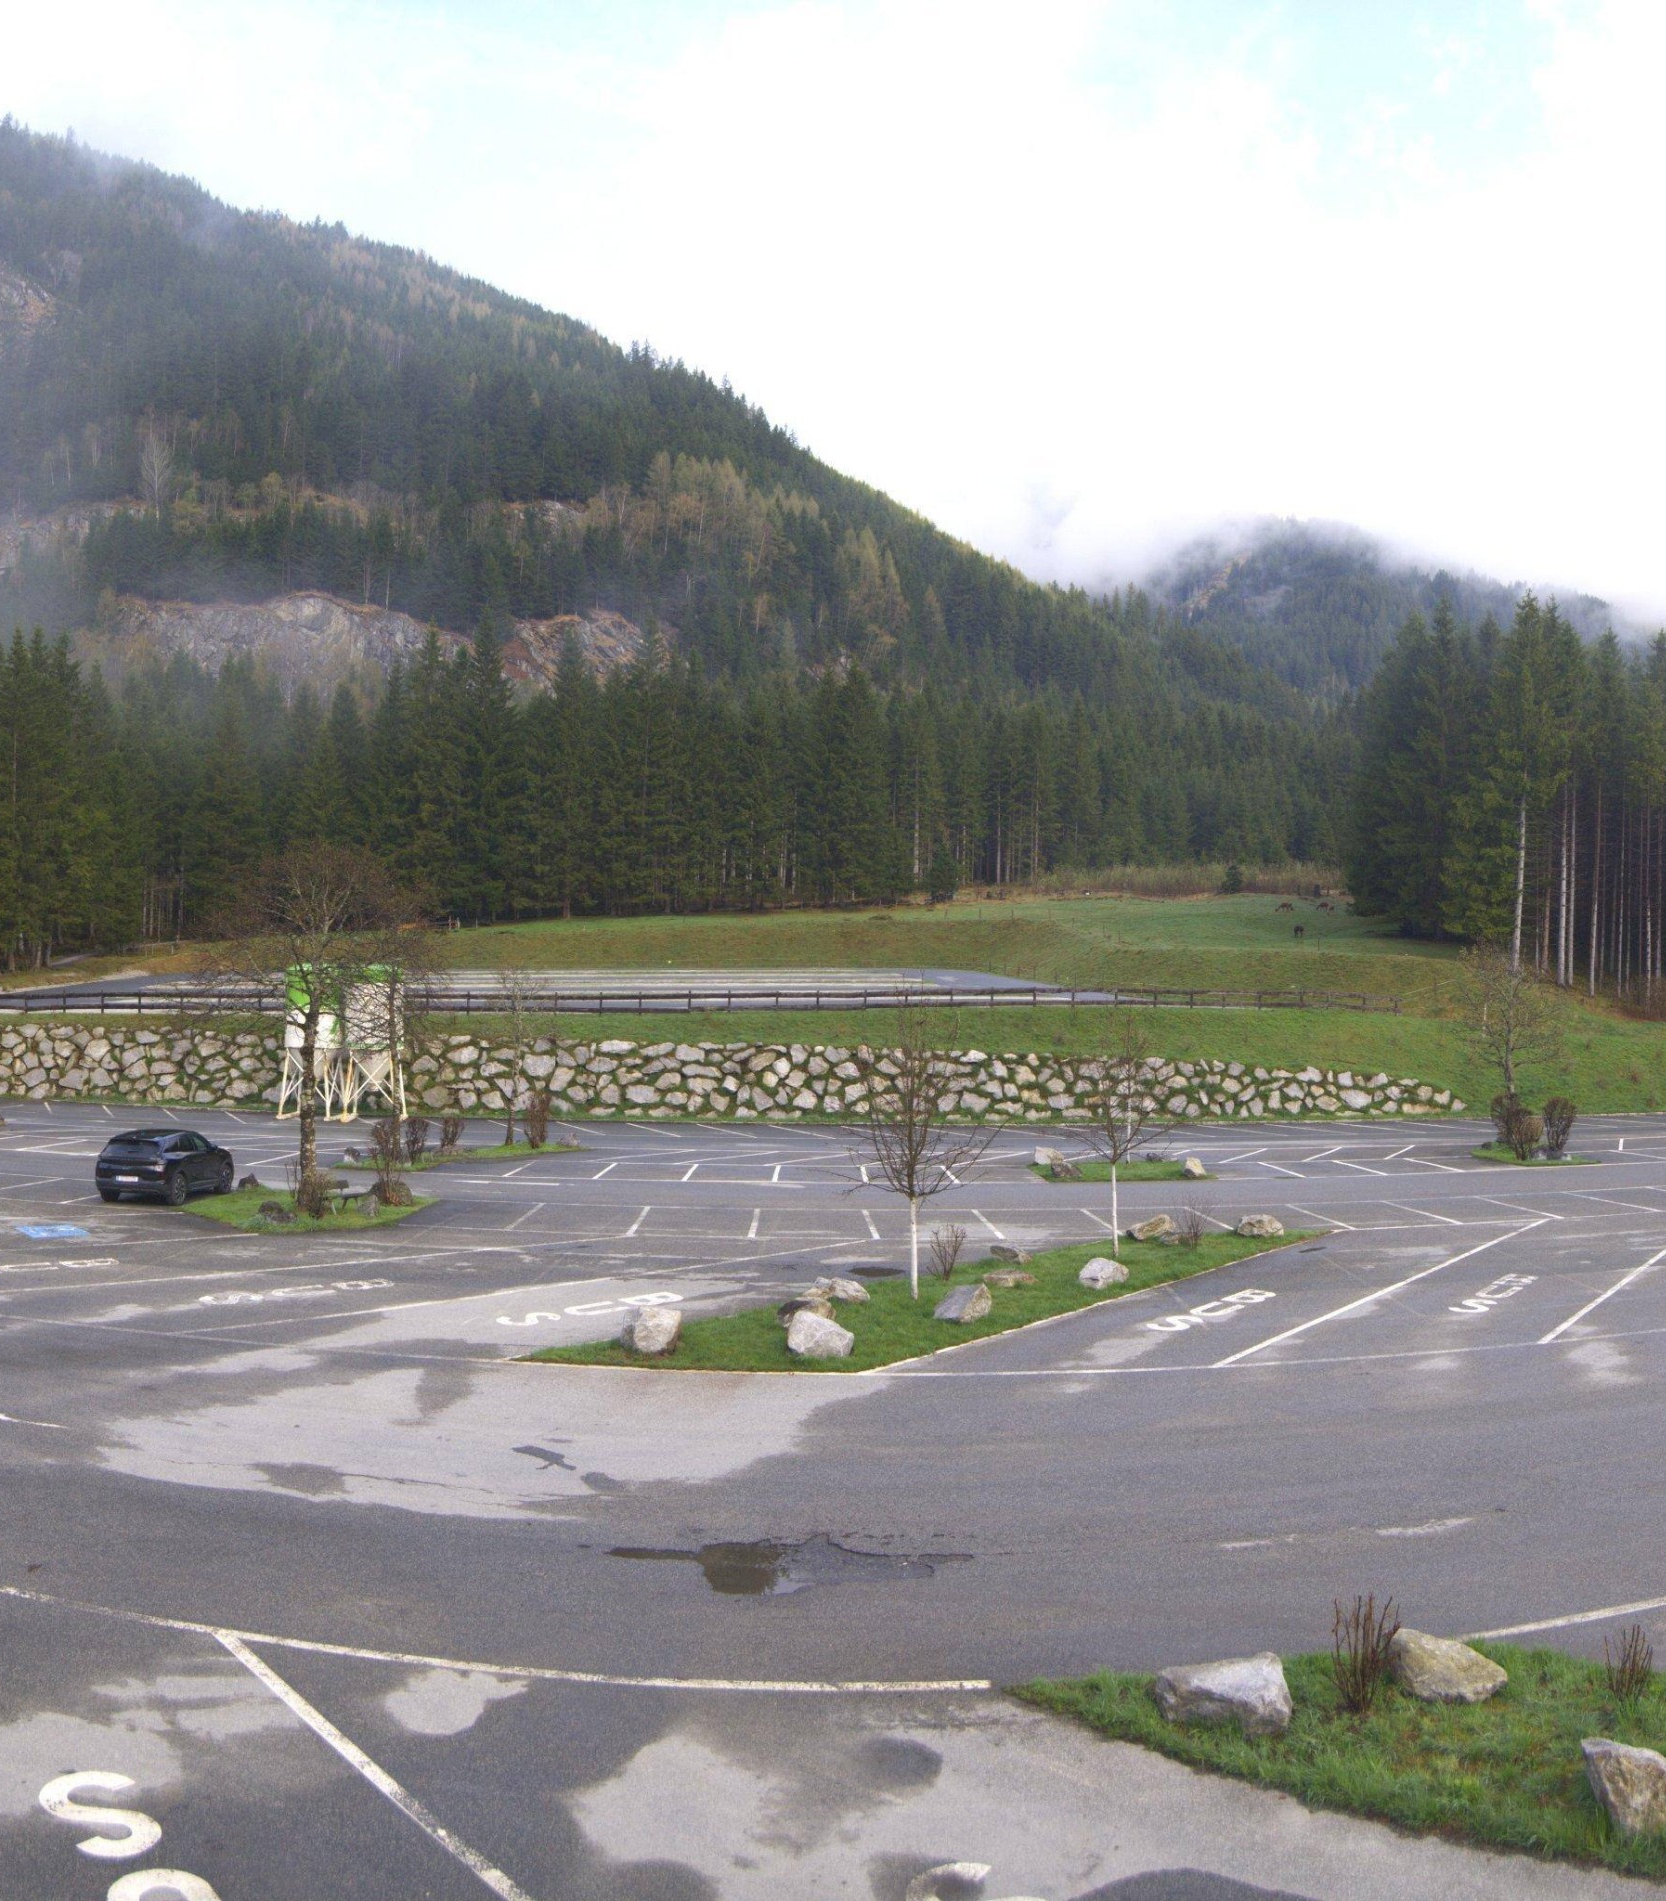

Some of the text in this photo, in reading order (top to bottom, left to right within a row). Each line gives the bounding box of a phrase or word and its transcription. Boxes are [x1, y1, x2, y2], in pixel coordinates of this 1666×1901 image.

[496, 1291, 685, 1327] BUS
[1146, 1288, 1277, 1331] BUS
[1448, 1273, 1539, 1313] BUS
